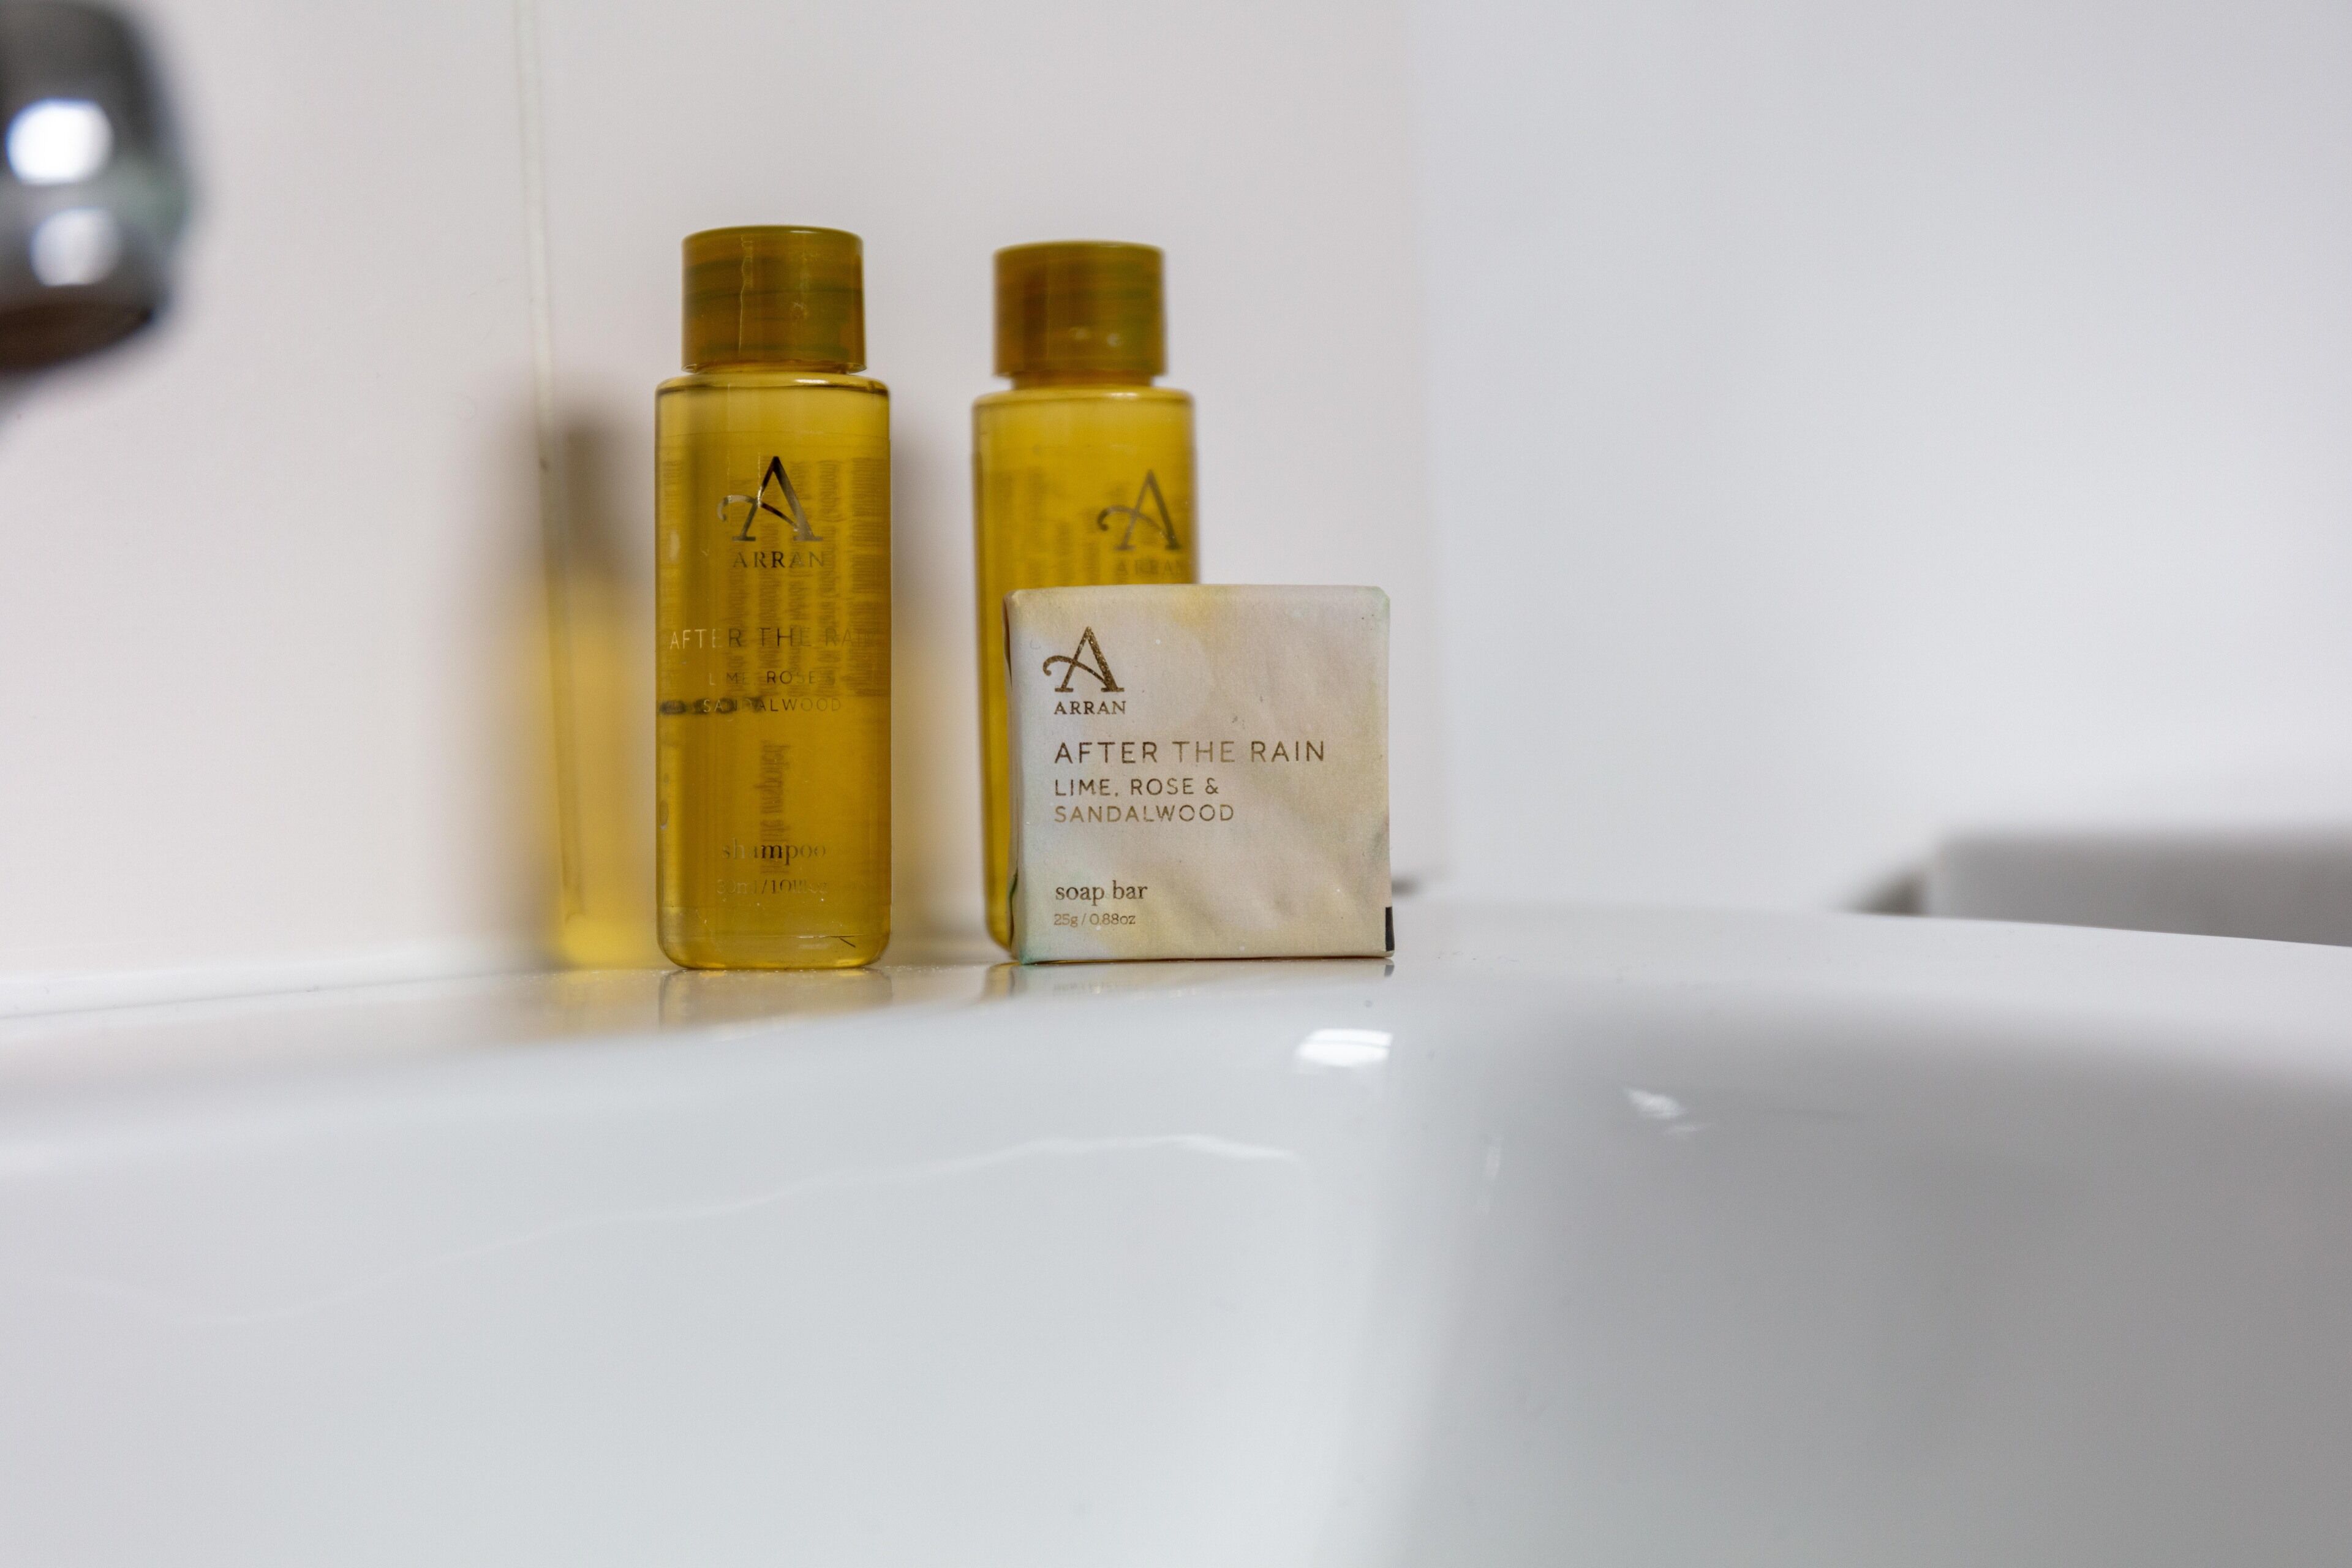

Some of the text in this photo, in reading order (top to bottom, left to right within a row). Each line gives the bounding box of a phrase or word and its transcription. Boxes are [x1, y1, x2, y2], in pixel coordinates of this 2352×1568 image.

[733, 551, 824, 568] ARRAN
[670, 628, 742, 649] AFTER
[760, 627, 812, 647] THE
[767, 670, 816, 685] ROSE
[1054, 701, 1127, 715] ARRAN
[1055, 740, 1325, 764] AFTER THE RAIN
[1055, 777, 1219, 797] LIME, ROSE &
[1055, 804, 1234, 823] SANDALWOOD
[1055, 880, 1148, 907] soap bar
[1054, 913, 1078, 928] 25g
[1090, 913, 1136, 925] 0.88oz
